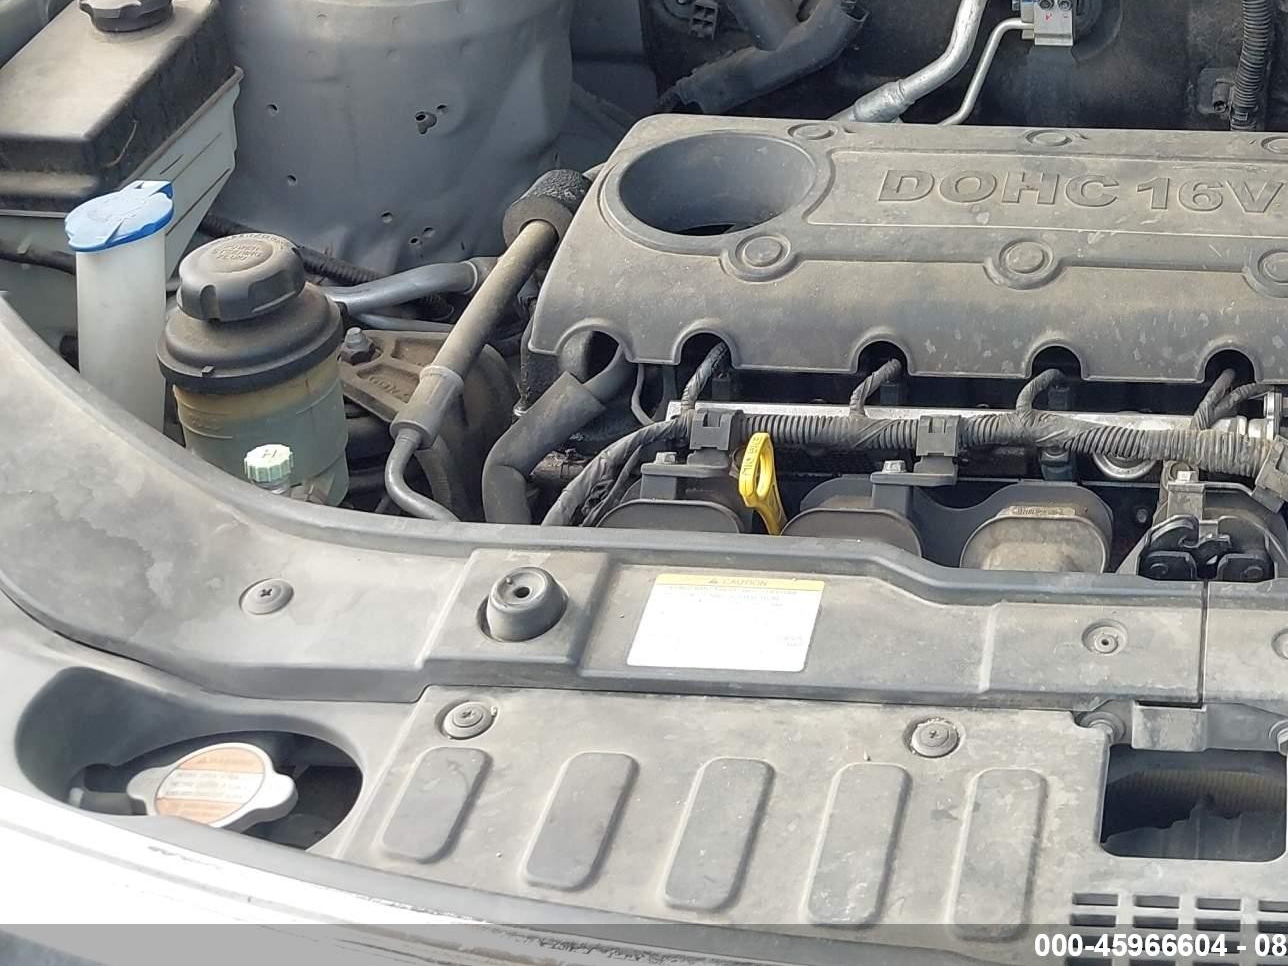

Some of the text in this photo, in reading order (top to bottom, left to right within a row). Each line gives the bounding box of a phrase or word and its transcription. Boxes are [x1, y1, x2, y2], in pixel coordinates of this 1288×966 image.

[877, 168, 1285, 214] DOHC 16V
[722, 577, 768, 586] CAUTION
